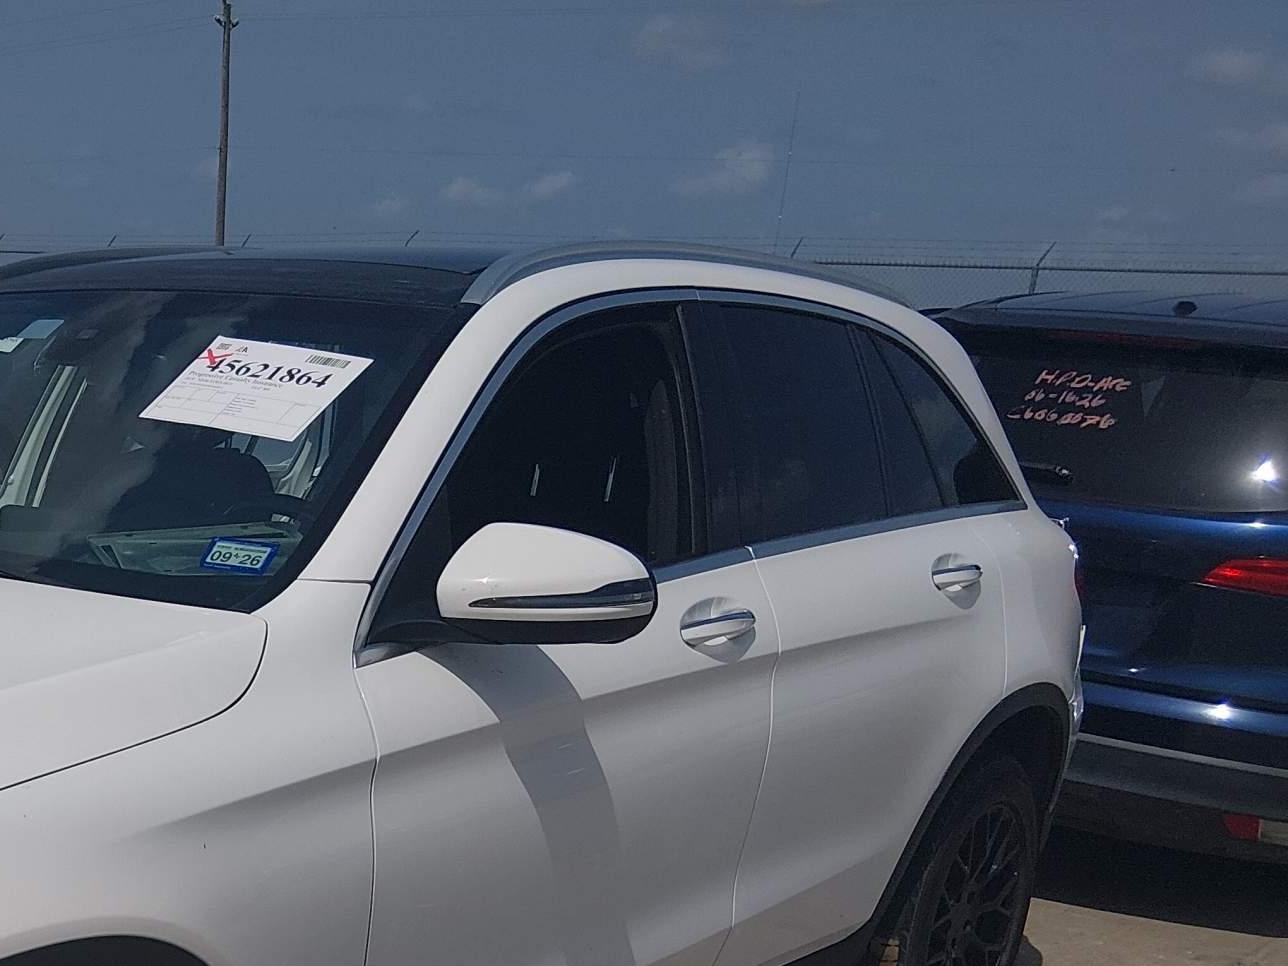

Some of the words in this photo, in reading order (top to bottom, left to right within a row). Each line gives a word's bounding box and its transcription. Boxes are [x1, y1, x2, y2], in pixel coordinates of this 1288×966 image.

[207, 358, 334, 389] 45621864
[210, 550, 232, 562] 09
[238, 554, 263, 566] 26
